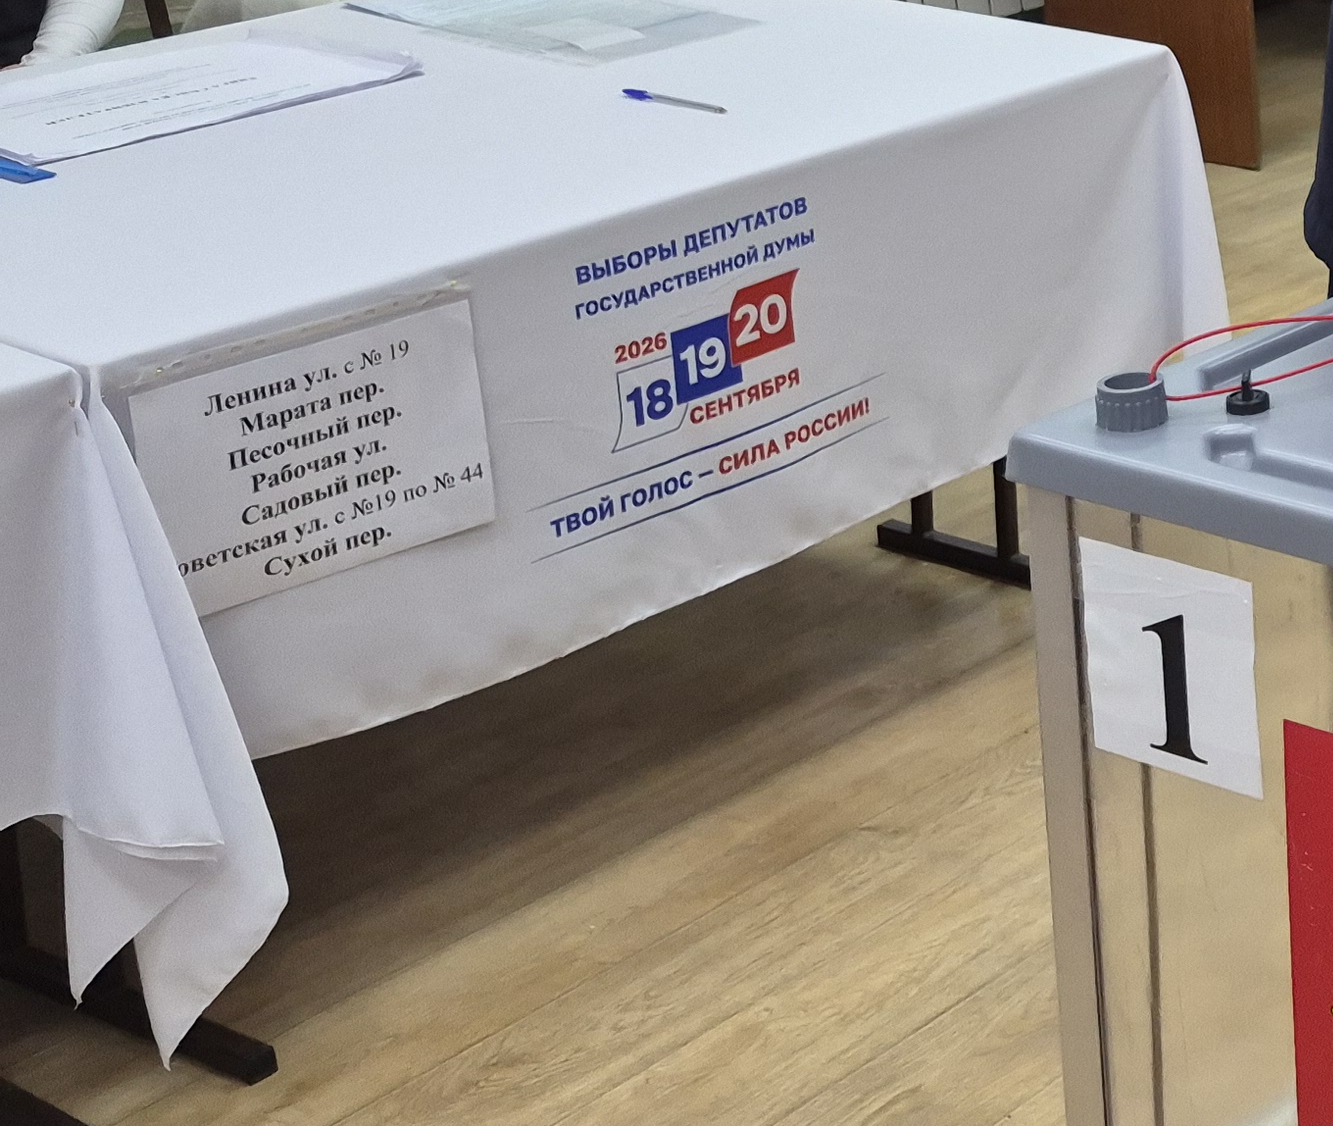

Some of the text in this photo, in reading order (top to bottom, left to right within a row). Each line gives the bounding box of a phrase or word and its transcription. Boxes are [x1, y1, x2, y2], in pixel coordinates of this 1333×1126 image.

[575, 196, 808, 285] ВЫБОРЫ ДЕПУТАТОВ
[575, 229, 815, 320] ГОСУДАРСТВЕННОЙ ДУМЫ
[615, 332, 667, 363] 2026
[735, 293, 787, 347] 20
[203, 339, 410, 417] Ленина ул. с № 19
[679, 337, 726, 385] 19
[239, 379, 385, 436] Марата пер.
[626, 378, 674, 428] 18
[689, 367, 800, 425] СЕНТЯБРЯ
[227, 404, 402, 471] Песочный пер.
[251, 440, 387, 494] Рабочая ул.
[550, 496, 615, 538] ТВОЙ
[620, 471, 694, 513] ГОЛОС
[718, 439, 781, 475] СИЛА
[785, 397, 870, 450] РОССИИ!
[176, 462, 484, 578] оветская ул. с №19 по № 44
[241, 464, 402, 526] Садовый пер.
[264, 524, 392, 577] Сухой пер.
[1141, 614, 1209, 765] 1
